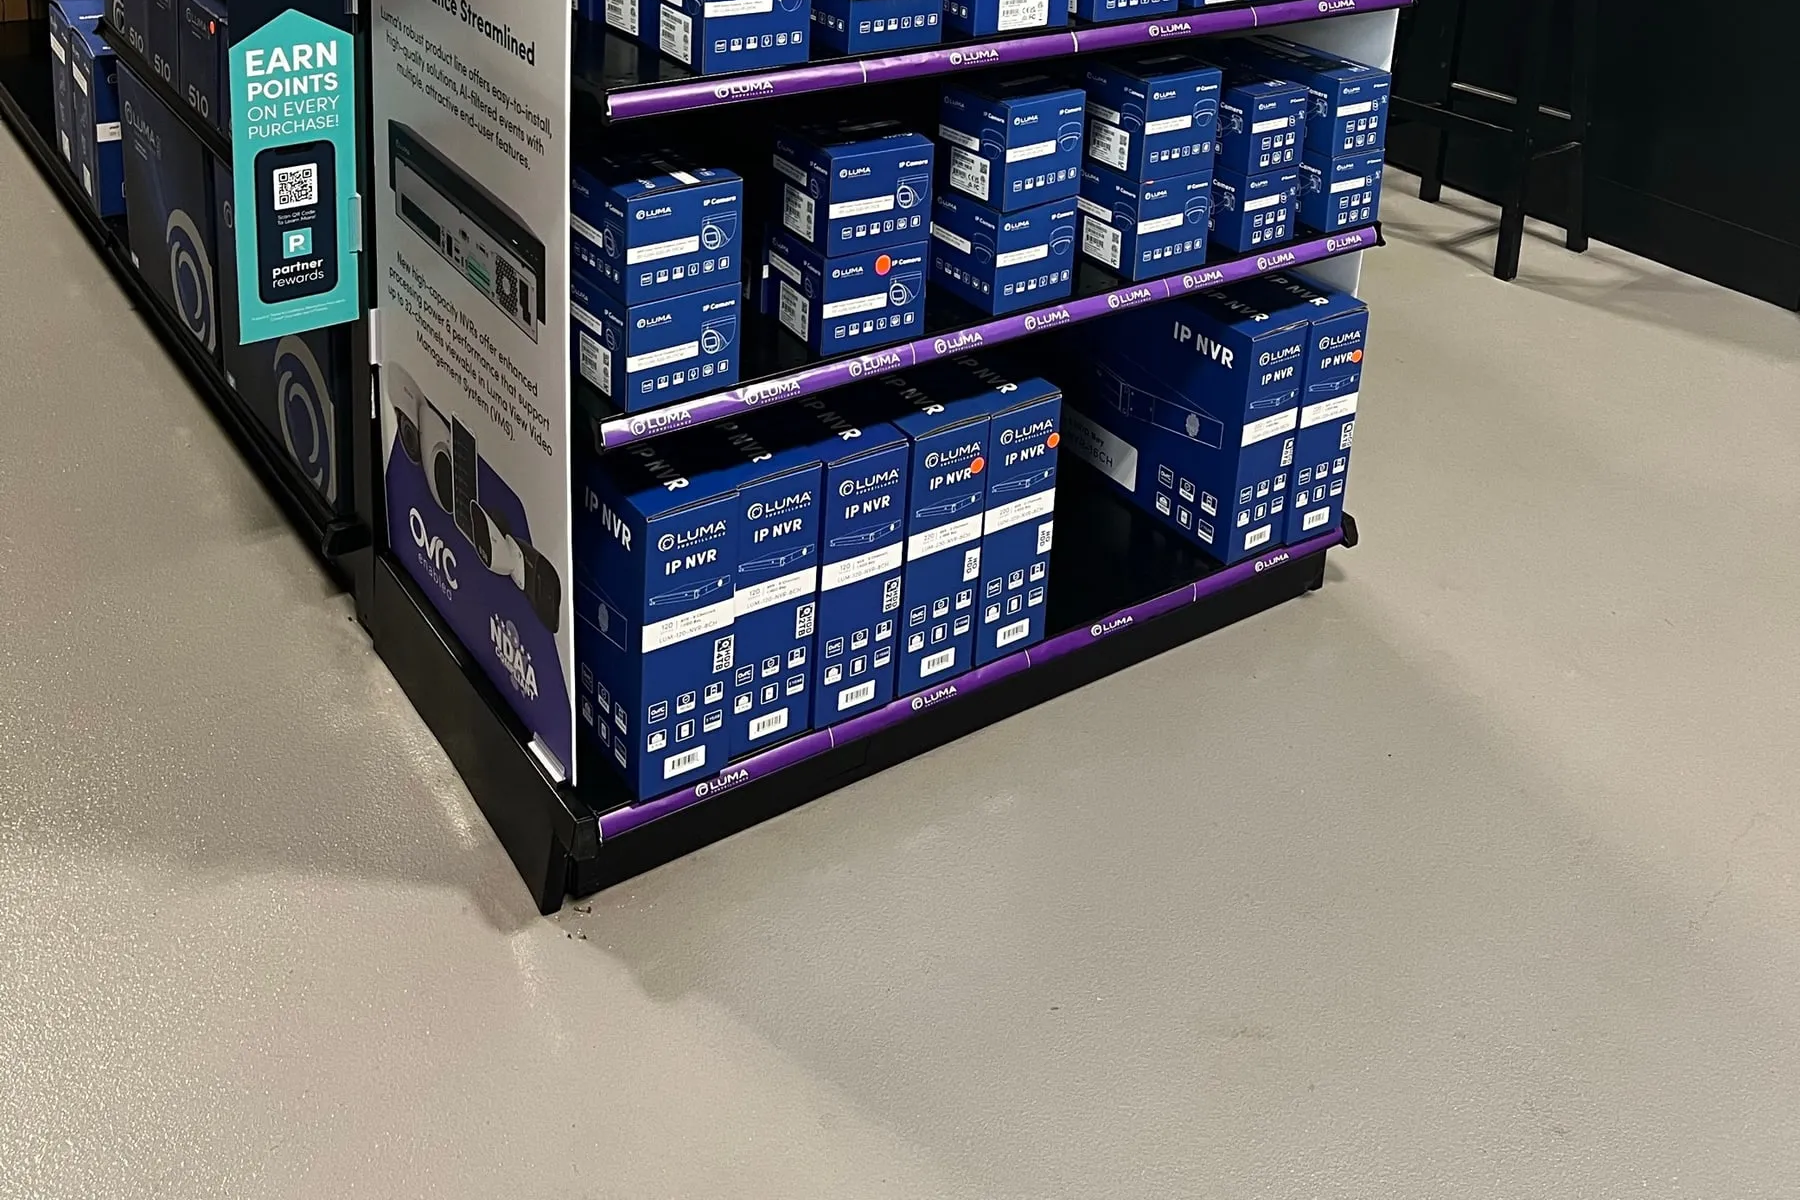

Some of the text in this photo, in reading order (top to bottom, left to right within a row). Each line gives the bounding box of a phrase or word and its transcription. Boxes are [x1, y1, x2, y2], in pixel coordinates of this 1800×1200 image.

[1160, 22, 1191, 35] LUMA
[129, 26, 144, 54] 510
[245, 40, 338, 78] EARN
[963, 49, 999, 63] LUMA
[154, 53, 171, 83] 510
[380, 4, 552, 140] Luma's robust product line offers easy-to-install,
[247, 72, 338, 102] POINTS
[386, 29, 544, 156] high-quality solutions, AI-filtered events with
[730, 79, 773, 96] LUMA
[188, 83, 209, 119] 510
[247, 95, 340, 122] ON EVERY
[396, 62, 531, 171] multiple, attractive end-user features.
[248, 115, 340, 140] PURCHASE!
[848, 166, 871, 176] LUMA
[646, 207, 672, 217] LUMA
[1336, 234, 1362, 248] LUMA
[272, 259, 324, 279] partner
[1267, 251, 1295, 266] LUMA
[272, 269, 324, 288] rewards
[841, 266, 863, 276] LUMA
[1193, 270, 1223, 286] LUMA
[1118, 288, 1150, 305] LUMA
[397, 250, 538, 397] New high-capacity NVRs offer enhanced
[646, 313, 672, 325] LUMA
[1037, 309, 1070, 328] LUMA
[389, 266, 422, 308] processing
[423, 300, 445, 326] power
[452, 329, 499, 382] performance
[501, 374, 517, 398] that
[518, 393, 550, 431] support
[948, 332, 983, 351] LUMA
[1173, 321, 1234, 370] IP NVR
[1329, 330, 1361, 346] LUMA
[861, 352, 900, 372] LUMA
[1270, 344, 1301, 361] LUMA
[1320, 352, 1352, 369] IP NVR
[388, 284, 553, 457] up to 32-channels viewable in Luma View Video
[1261, 366, 1294, 386] IP NVR
[416, 330, 516, 442] Management System (VMS).
[1015, 419, 1054, 438] LUMA
[940, 442, 981, 462] LUMA
[1005, 444, 1045, 467] IP NVR
[856, 468, 900, 490] LUMA
[929, 467, 971, 491] IP NVR
[765, 491, 812, 513] LUMA
[844, 495, 890, 519] IP NVR
[584, 485, 632, 552] IP NVR
[677, 520, 726, 544] LUMA
[754, 518, 802, 543] IP NVR
[665, 548, 717, 575] IP NVR
[1264, 552, 1289, 568] LUMA
[417, 552, 453, 601] enabled
[798, 617, 806, 636] 2TB
[1103, 615, 1133, 631] LUMA
[490, 616, 539, 698] NDAA
[715, 651, 724, 670] 4TB
[924, 685, 957, 704] LUMA
[710, 768, 749, 790] LUMA
